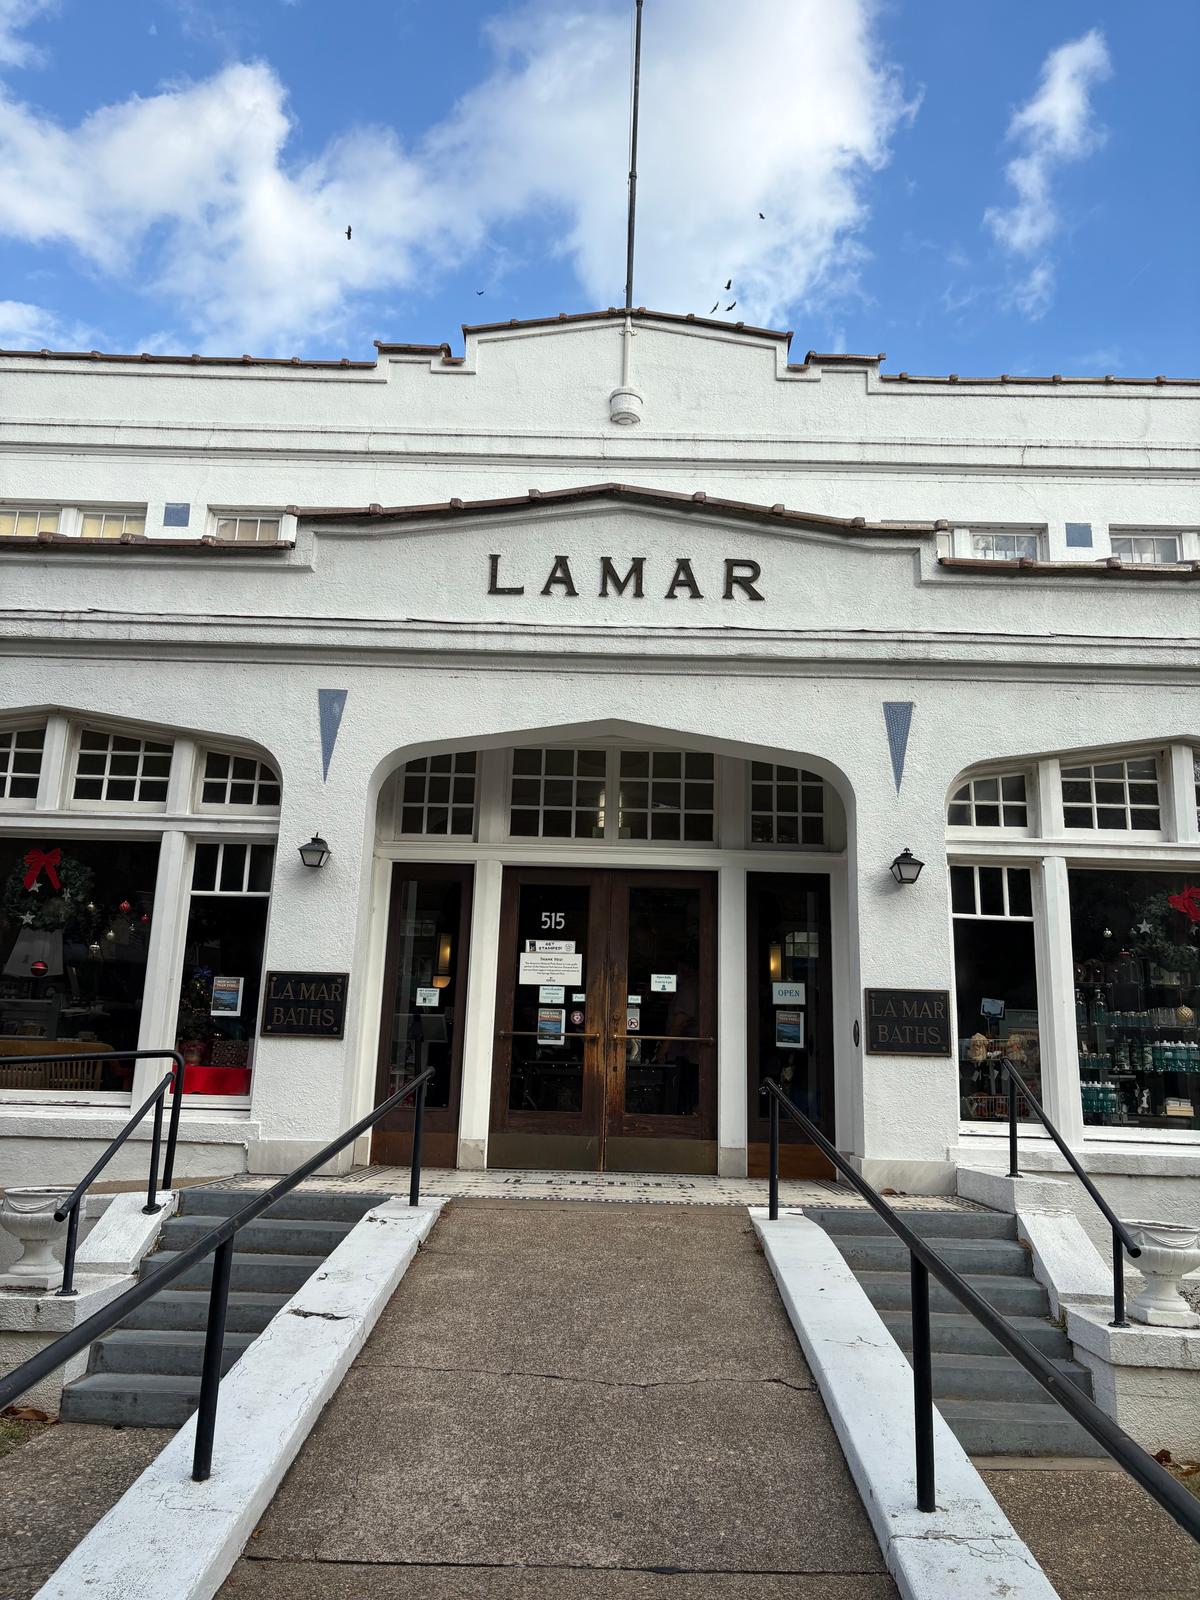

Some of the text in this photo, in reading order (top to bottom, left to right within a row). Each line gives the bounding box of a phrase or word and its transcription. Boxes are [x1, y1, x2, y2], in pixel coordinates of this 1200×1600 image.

[487, 554, 765, 601] LAMAR
[541, 913, 566, 930] 515
[270, 981, 342, 1001] LA MAR
[778, 989, 800, 997] OPEN
[271, 1006, 335, 1027] BATHS
[871, 998, 945, 1019] LA MAR
[877, 1024, 941, 1045] BATHS
